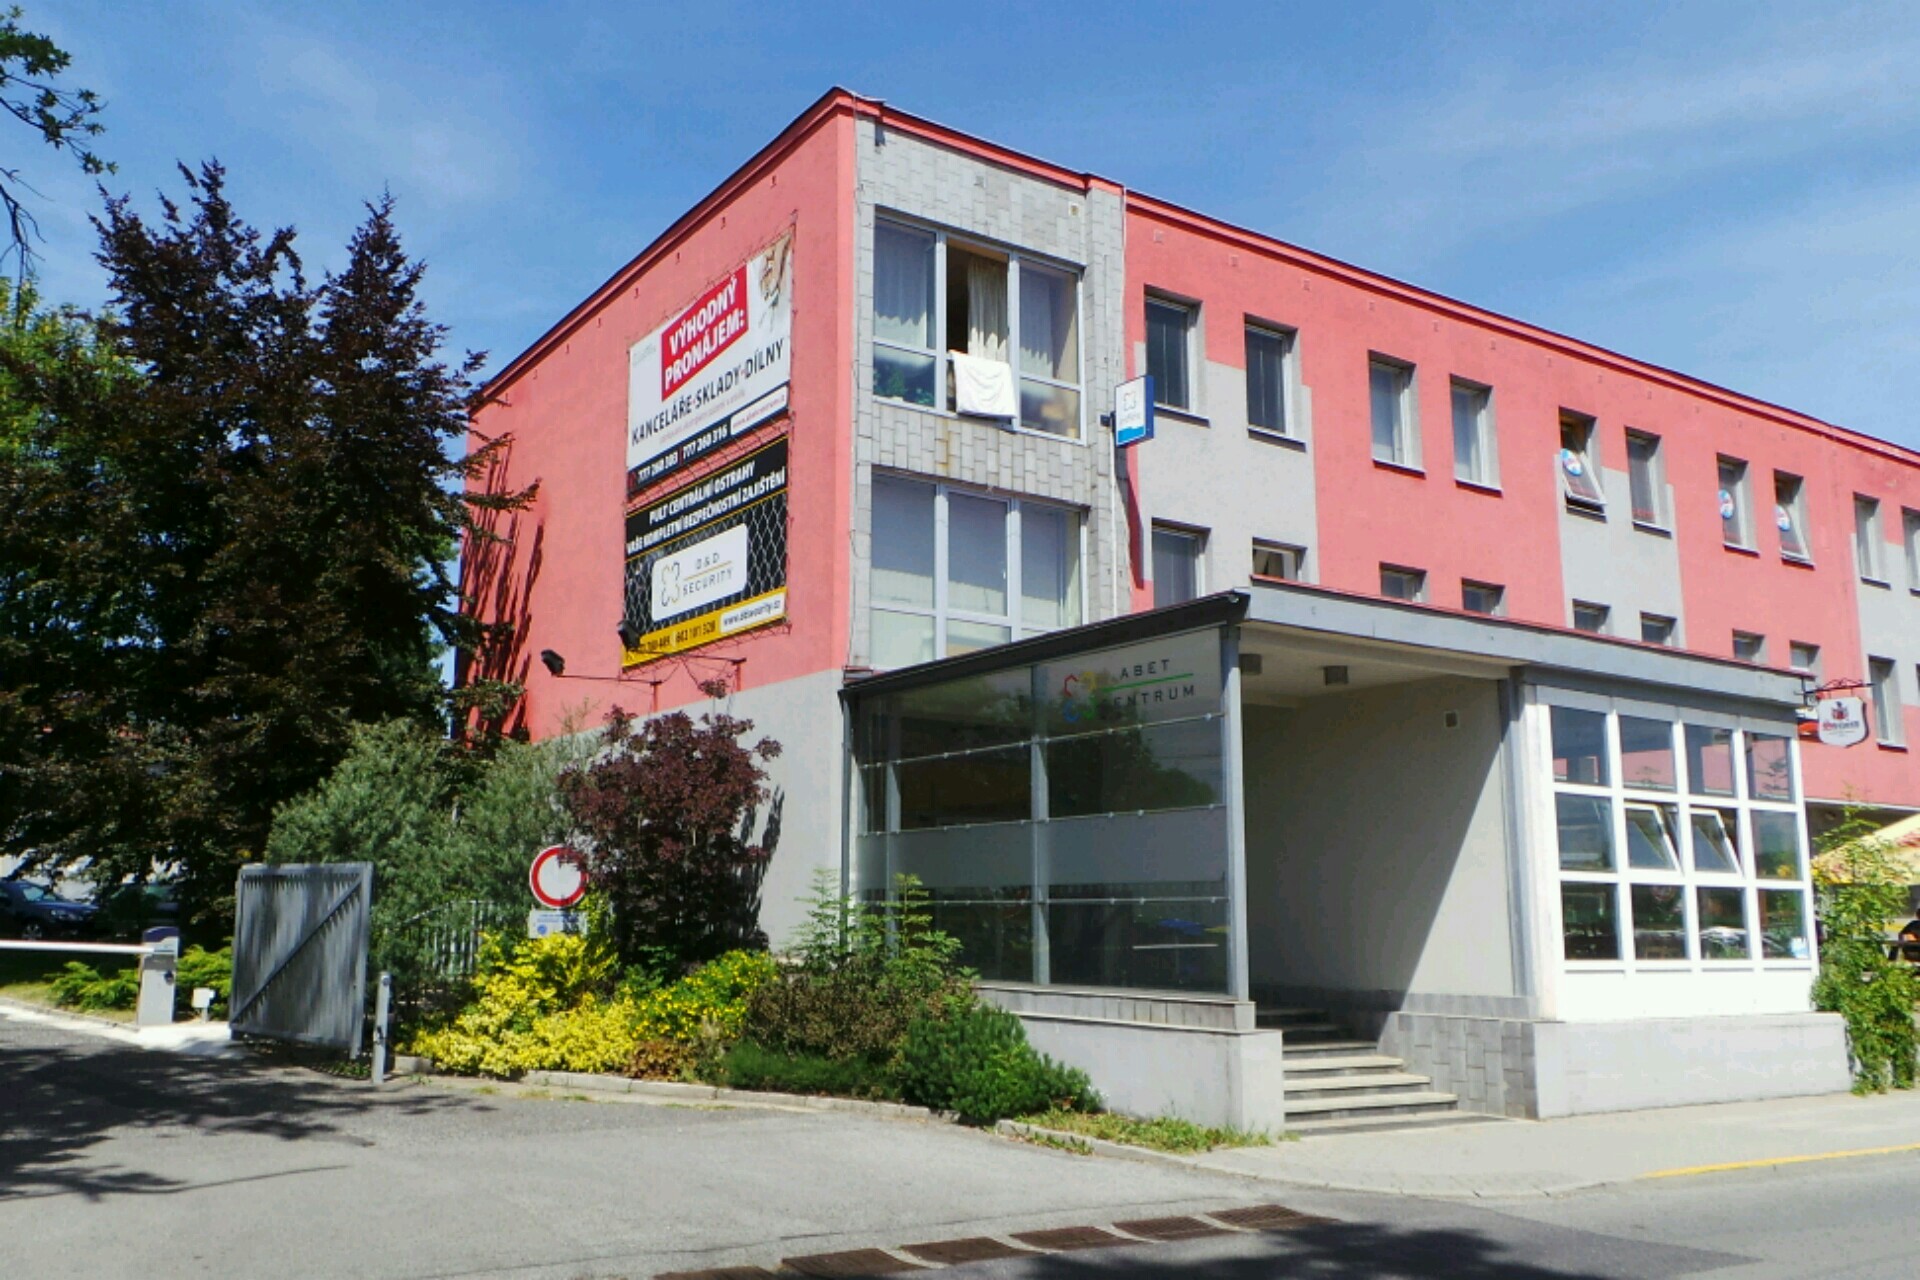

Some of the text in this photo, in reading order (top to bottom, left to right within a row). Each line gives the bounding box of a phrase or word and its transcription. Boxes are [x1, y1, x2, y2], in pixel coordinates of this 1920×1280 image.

[669, 274, 738, 355] VÝHODNÝ
[664, 309, 745, 391] PRONÁJEM:
[715, 460, 755, 494] OSTRAHY
[682, 568, 733, 597] SECURITY
[1119, 658, 1171, 680] ABET
